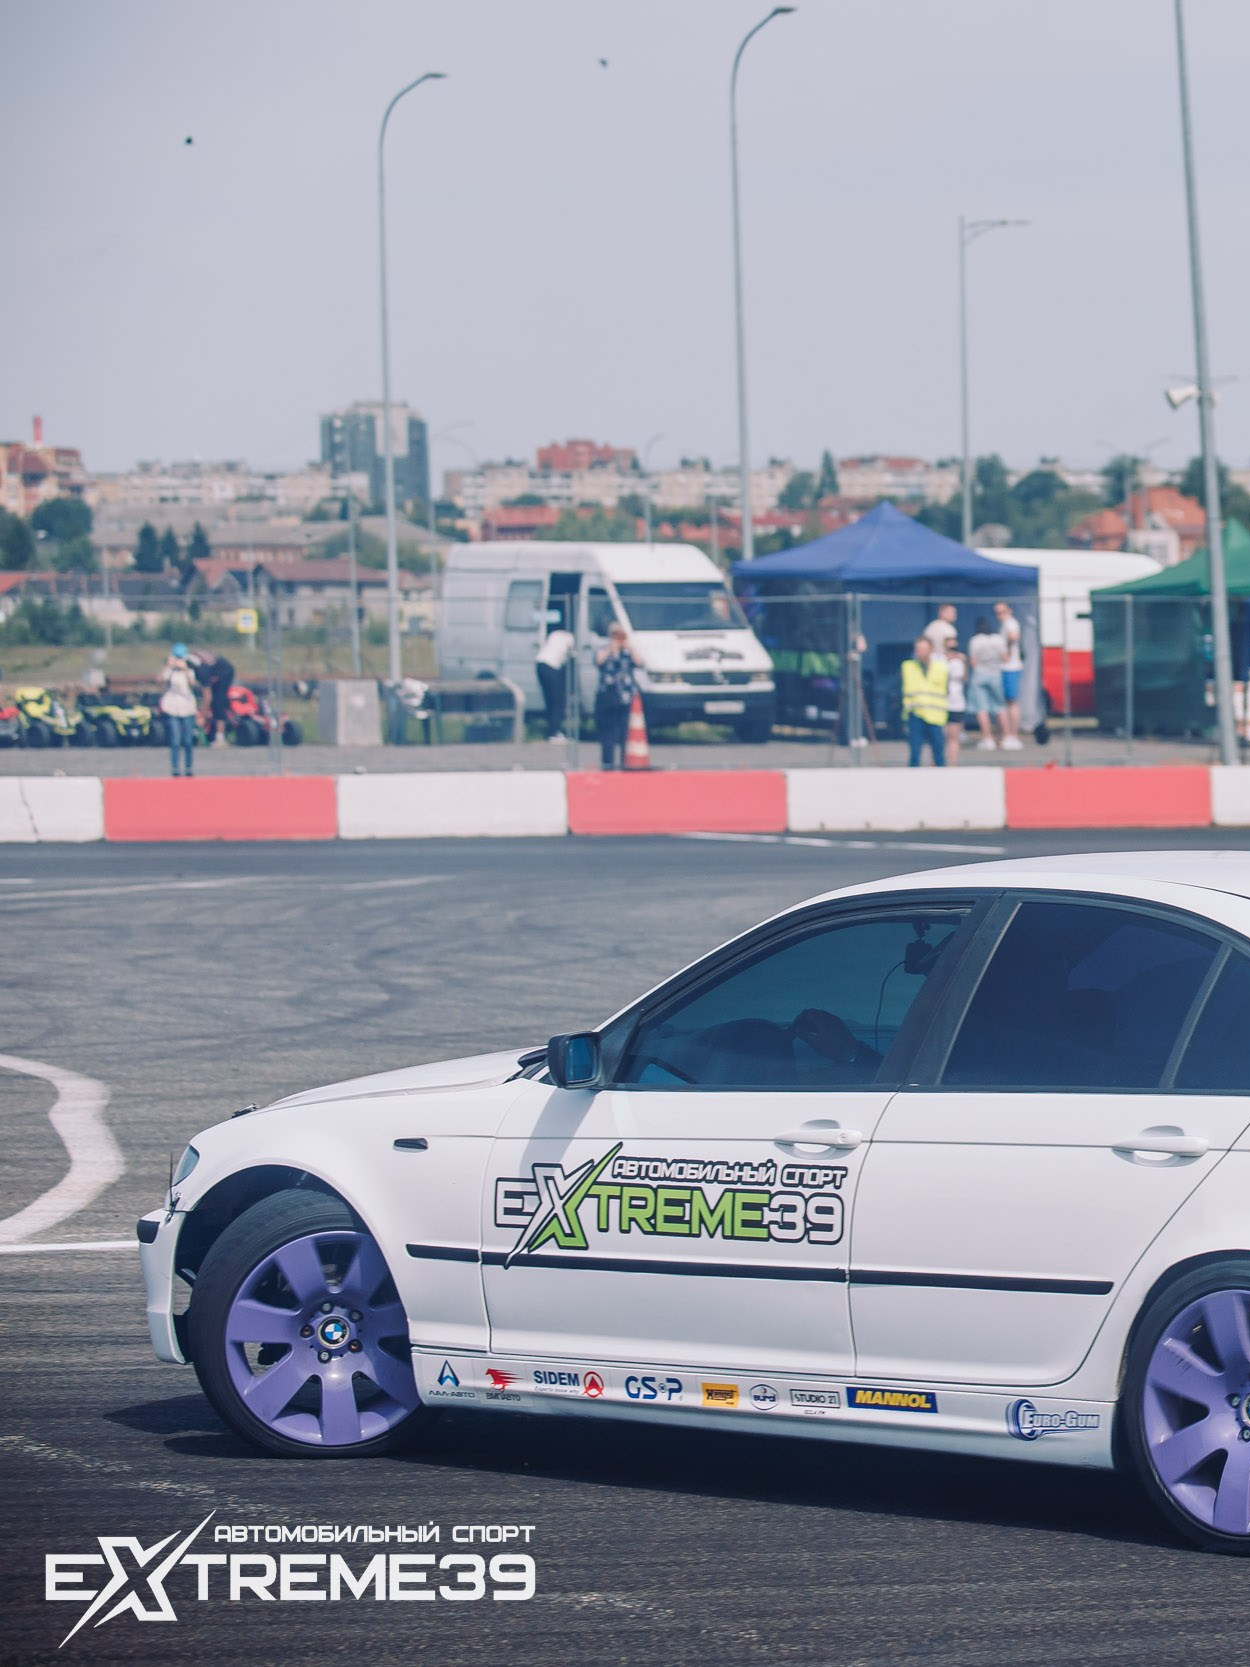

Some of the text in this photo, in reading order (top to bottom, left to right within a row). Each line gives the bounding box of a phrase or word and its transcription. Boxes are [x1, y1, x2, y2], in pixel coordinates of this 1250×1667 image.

[613, 1155, 848, 1189] АВТОМОБИЛЬНЫЙ СПОРТ
[494, 1141, 845, 1270] EXTREME39
[533, 1370, 580, 1387] SIDEM
[794, 1393, 837, 1405] STUDIO 21
[855, 1390, 932, 1409] MANNOL
